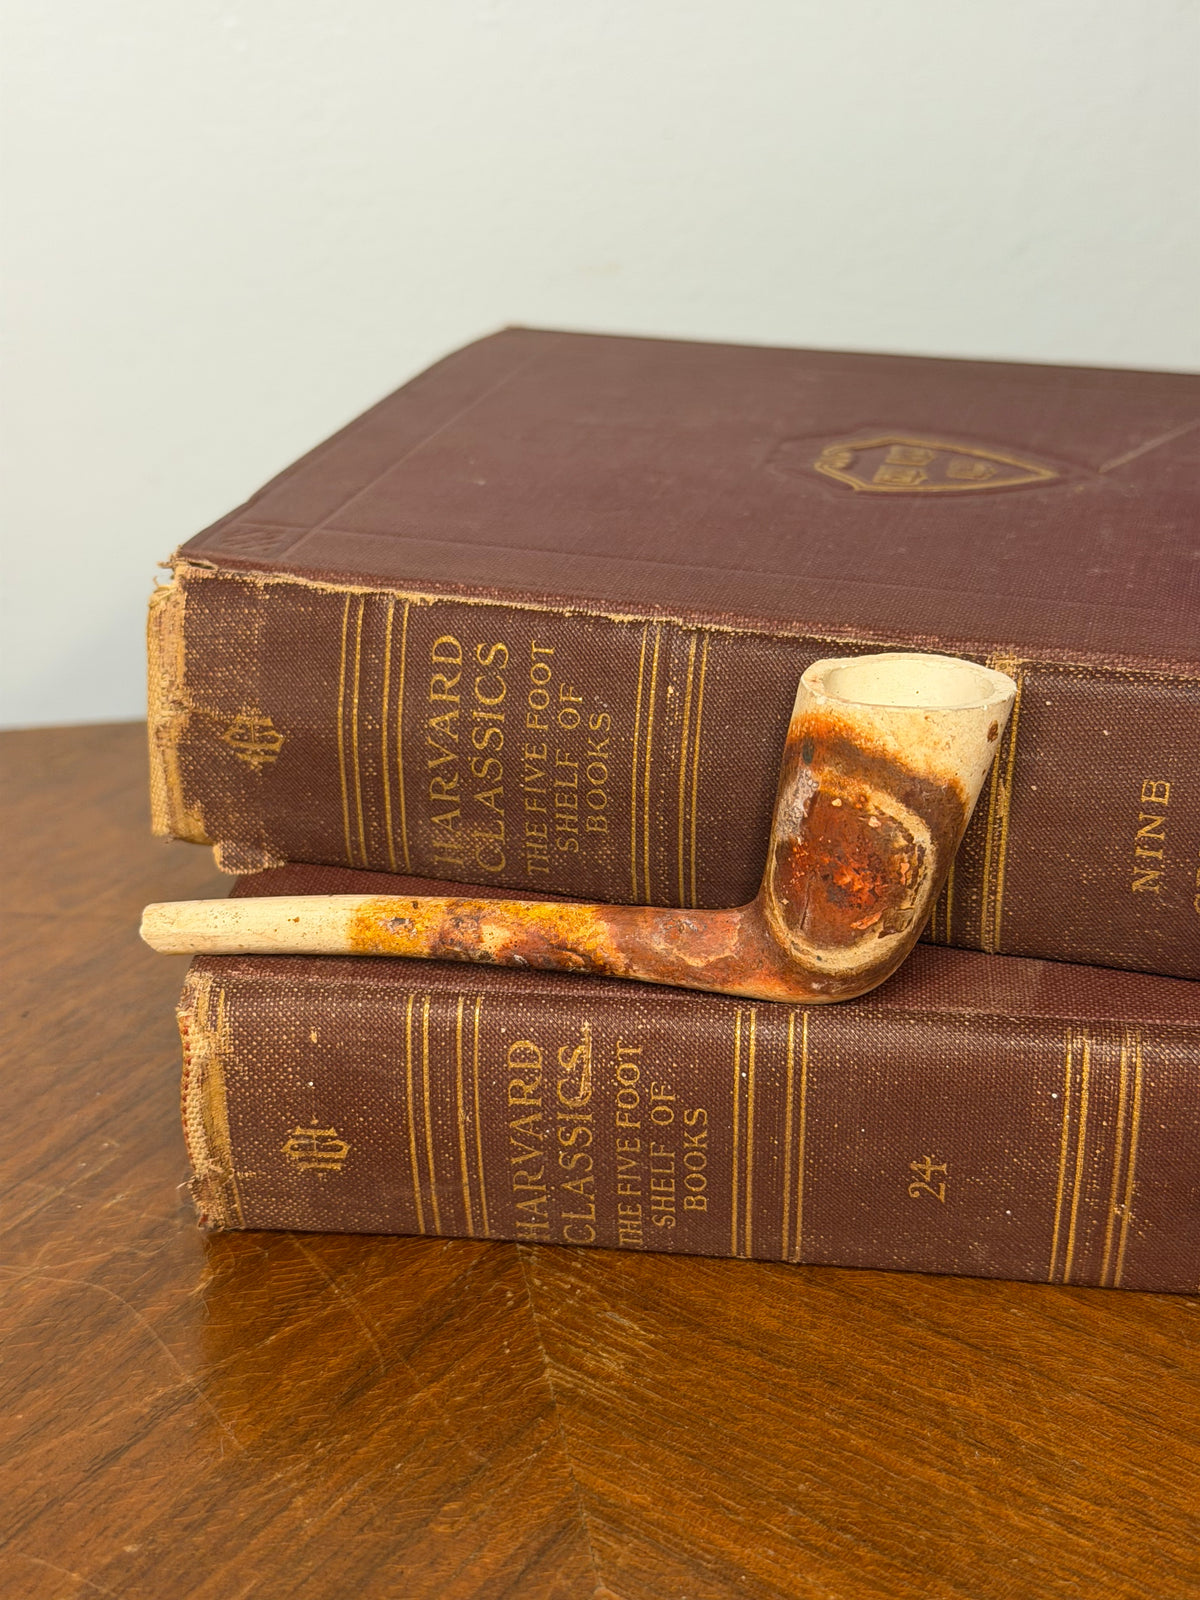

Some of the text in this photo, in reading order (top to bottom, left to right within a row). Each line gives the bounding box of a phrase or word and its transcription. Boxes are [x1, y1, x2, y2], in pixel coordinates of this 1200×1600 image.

[425, 634, 463, 867] HARVARD
[470, 641, 510, 874] CLASSICS
[524, 640, 556, 875] THE FIVE FOOT
[555, 682, 583, 853] SHELF OF
[586, 711, 612, 833] BOOKS
[507, 1039, 551, 1241] HARVARD
[556, 1044, 597, 1244] CLASSICS
[615, 1040, 644, 1247] THE FIVE FOOT
[649, 1081, 677, 1229] SHELF OF
[683, 1107, 709, 1212] BOOKS
[907, 1154, 948, 1204] 24
